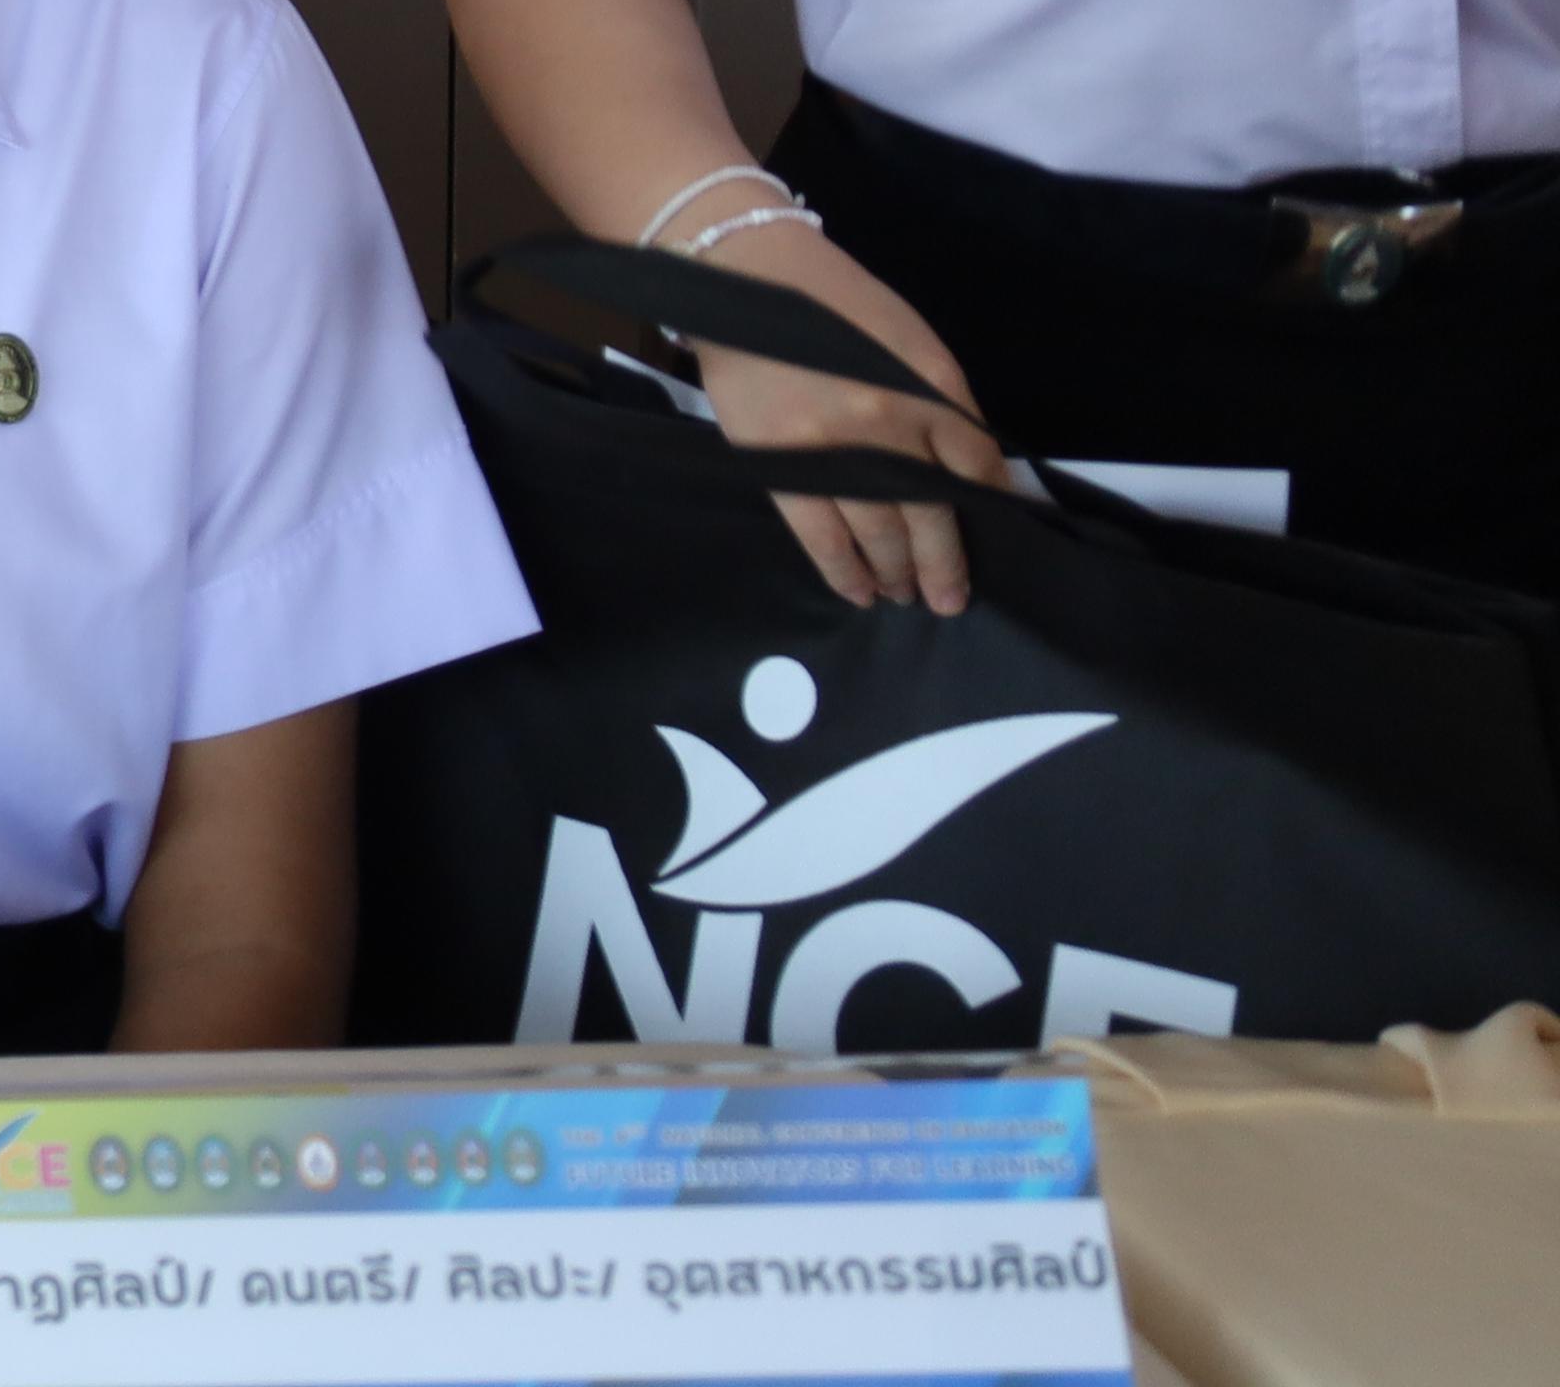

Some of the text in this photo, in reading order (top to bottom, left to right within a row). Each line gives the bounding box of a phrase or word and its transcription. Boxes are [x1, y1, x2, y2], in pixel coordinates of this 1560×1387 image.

[241, 1252, 420, 1305] ดนตรี/
[447, 1253, 616, 1303] ศิลปะ/
[644, 1238, 1108, 1314] อุตสาหกรรมศิลป์
